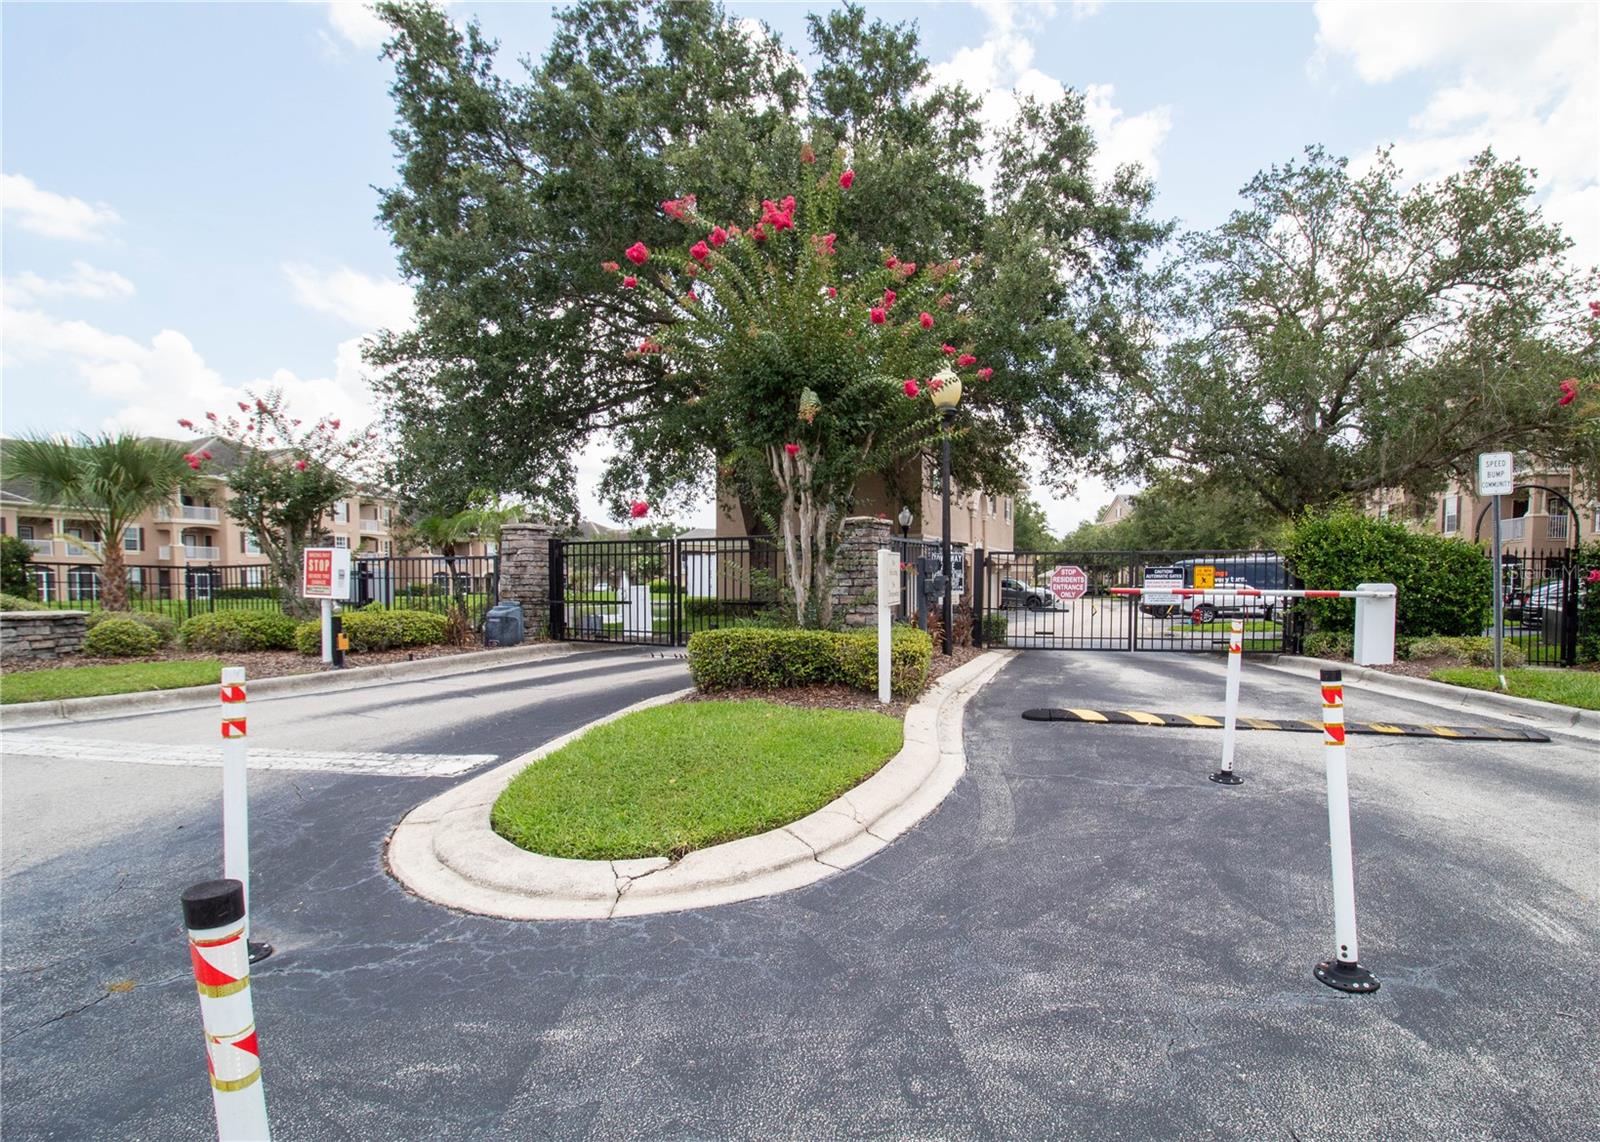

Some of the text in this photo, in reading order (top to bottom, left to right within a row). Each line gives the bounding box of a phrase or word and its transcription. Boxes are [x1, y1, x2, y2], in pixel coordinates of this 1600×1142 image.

[1485, 460, 1505, 468] SPEED
[1487, 470, 1505, 478] BUMP
[308, 559, 330, 571] STOP
[1052, 583, 1084, 591] ENTRANCE
